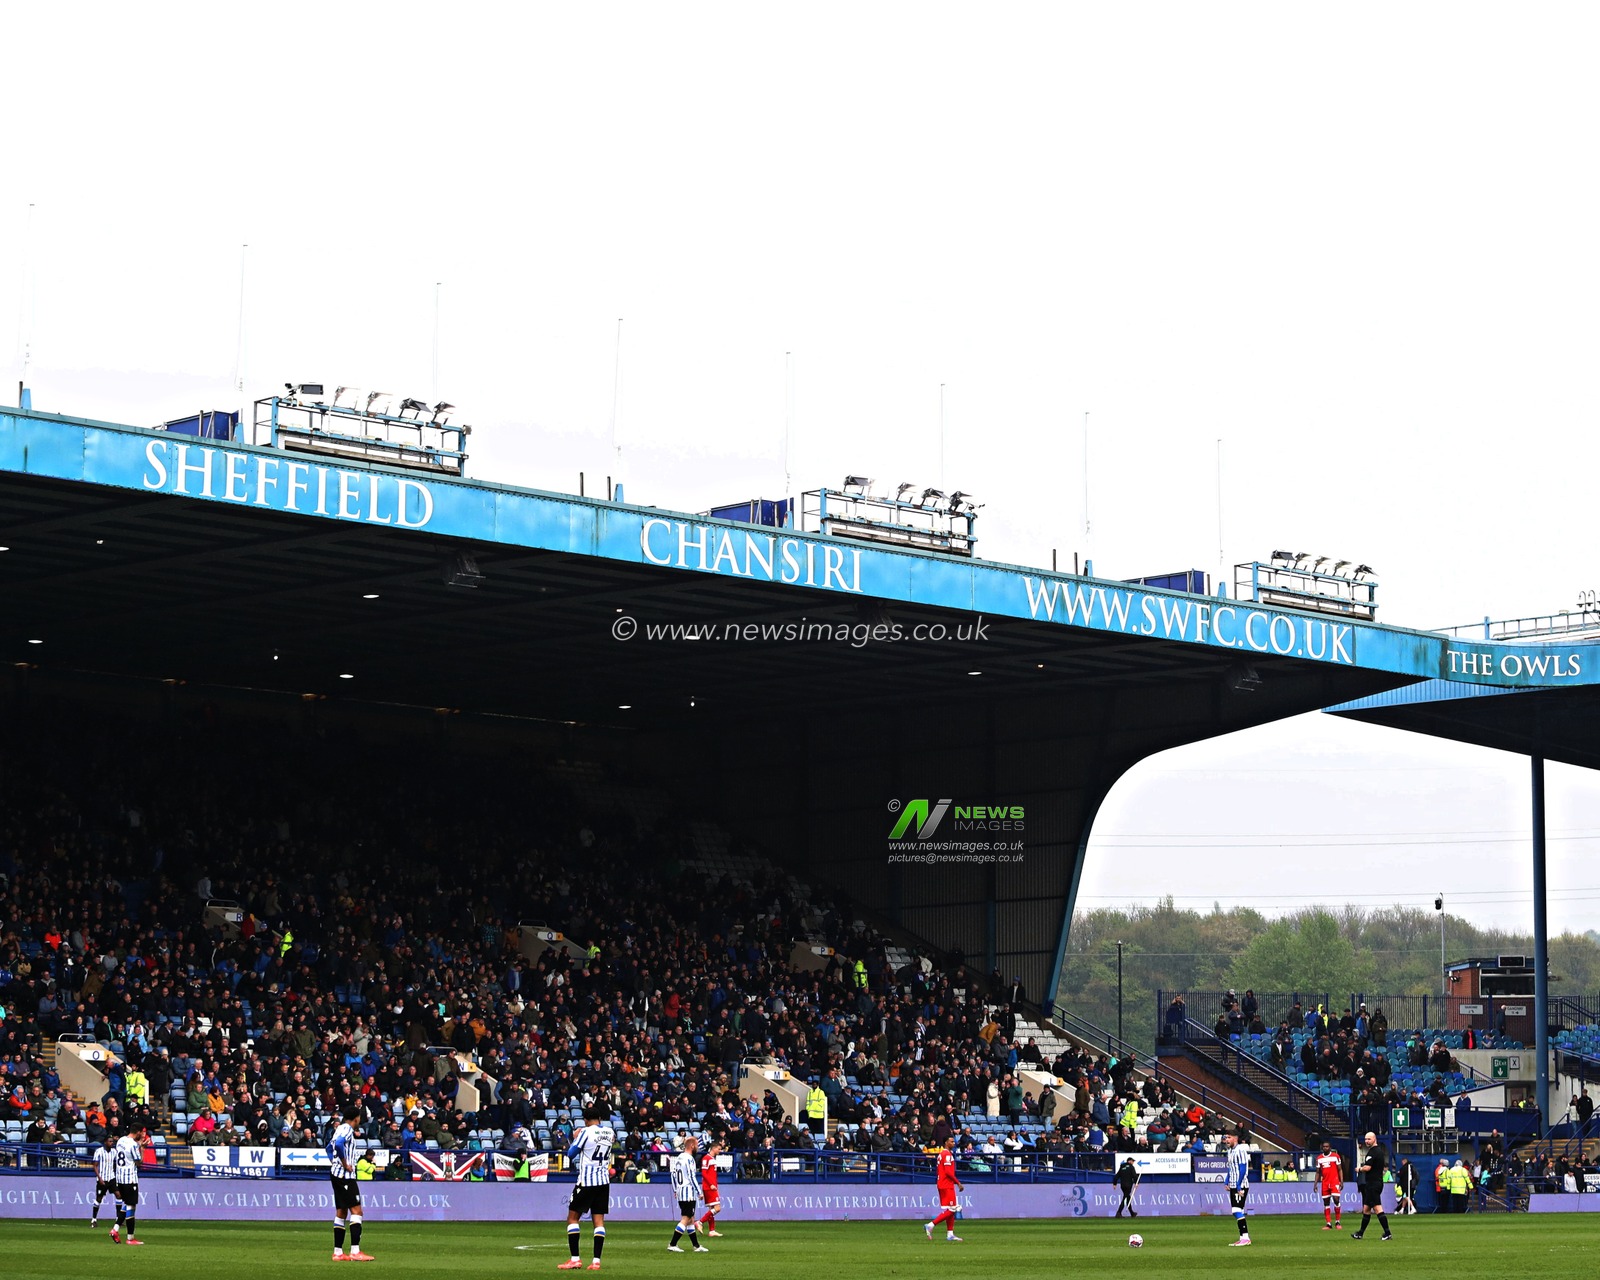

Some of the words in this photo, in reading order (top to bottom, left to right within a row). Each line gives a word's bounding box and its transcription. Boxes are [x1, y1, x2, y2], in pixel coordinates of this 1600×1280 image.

[143, 439, 434, 528] SHEFFIELD
[641, 518, 864, 593] CHANSIRI
[1022, 576, 1355, 665] WWW.SWFC.CO.UK
[1447, 649, 1494, 676] THE
[1500, 654, 1582, 678] OWLS
[740, 1067, 749, 1079] M
[773, 1071, 781, 1080] M
[117, 1151, 126, 1167] 8
[207, 1148, 217, 1162] S
[250, 1150, 265, 1164] W
[243, 1167, 269, 1177] 1867
[166, 1191, 452, 1208] WWW.CHAPTER3DITAL.CO.UK
[748, 1195, 974, 1209] WWW.CHAPTER3DIGITAL.CUK
[1072, 1185, 1089, 1216] 3
[1094, 1193, 1146, 1206] DIGIAL
[1150, 1193, 1196, 1206] AGENCY
